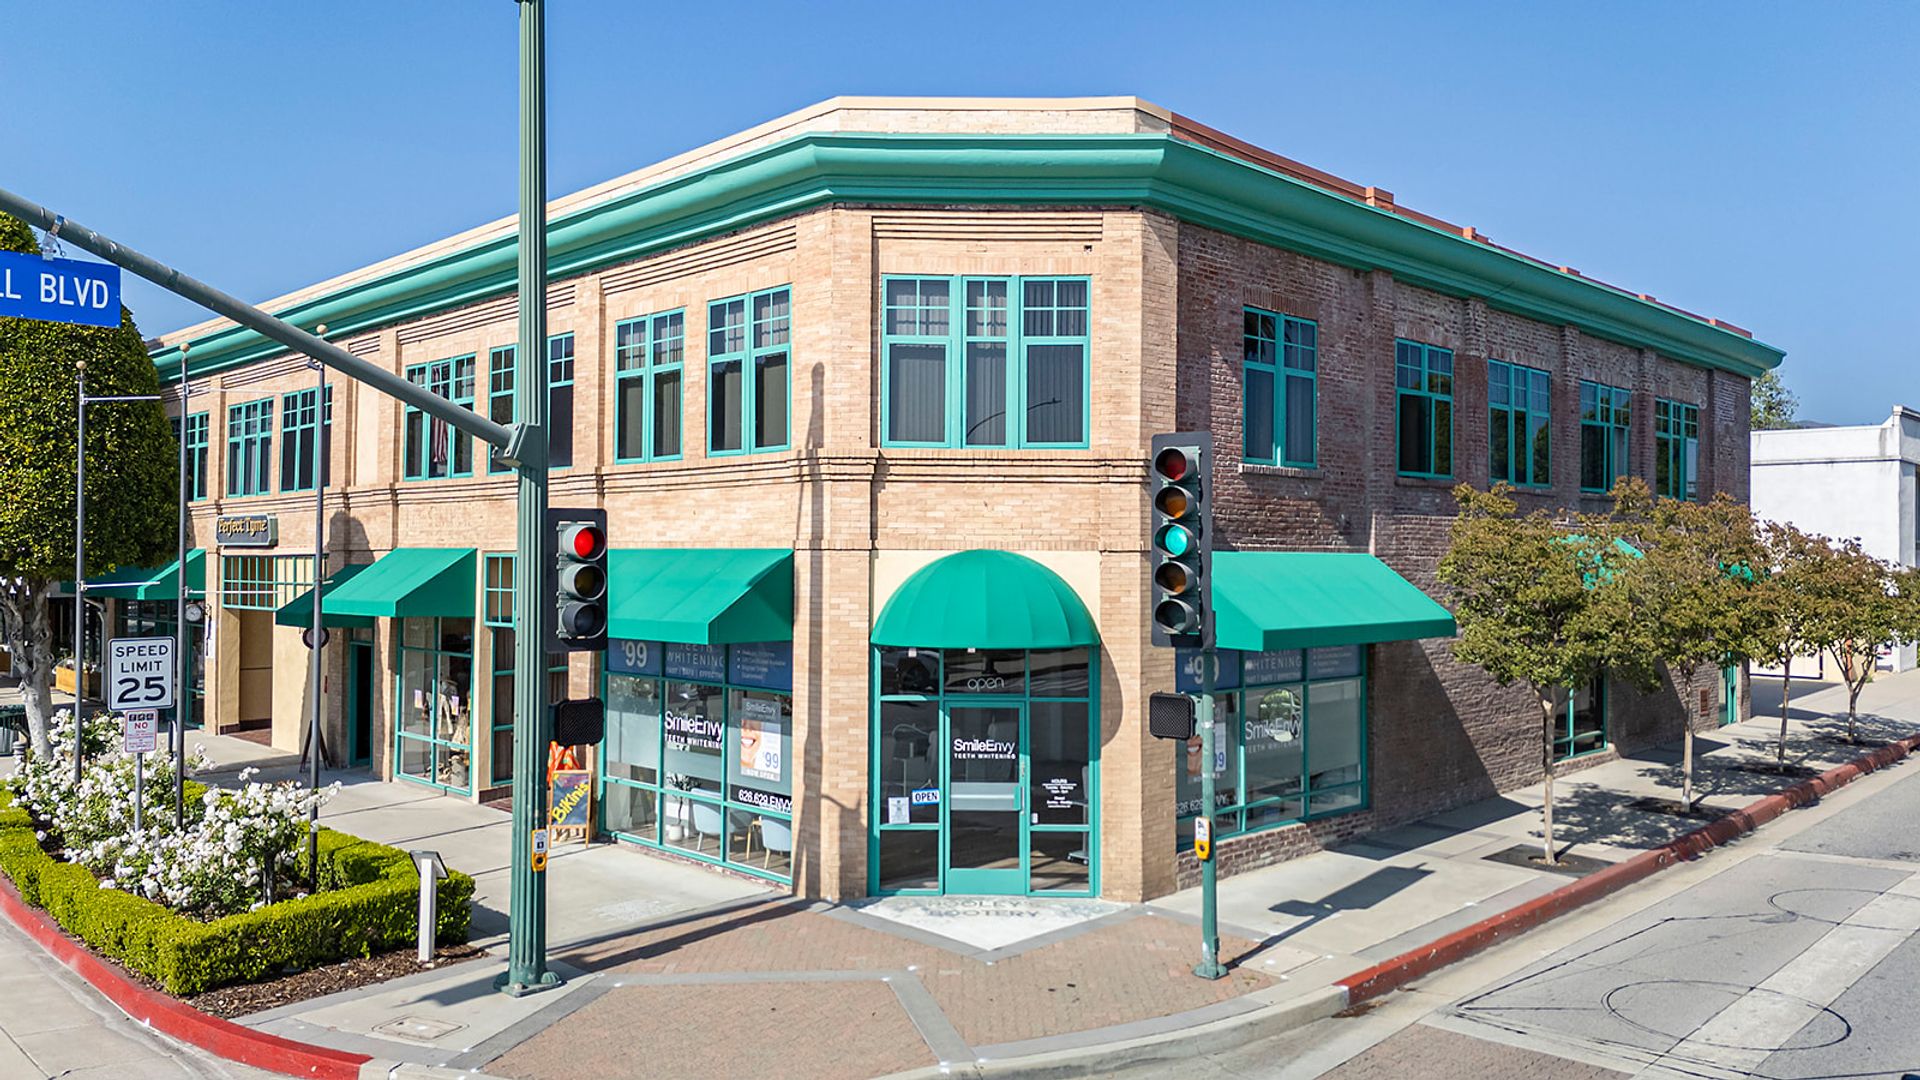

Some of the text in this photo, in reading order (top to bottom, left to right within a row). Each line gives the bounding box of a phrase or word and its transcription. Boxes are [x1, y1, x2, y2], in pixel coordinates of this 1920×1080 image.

[0, 269, 108, 308] L BLVD
[116, 645, 169, 658] SPEED
[121, 661, 162, 673] LIMIT
[117, 676, 167, 703] 25
[967, 677, 1004, 692] open
[664, 710, 724, 742] SmileEnvy
[1245, 717, 1301, 741] SmileEnvy
[665, 733, 685, 744] TEETH
[953, 738, 1015, 755] SmileEnvy
[915, 792, 938, 802] OPEN
